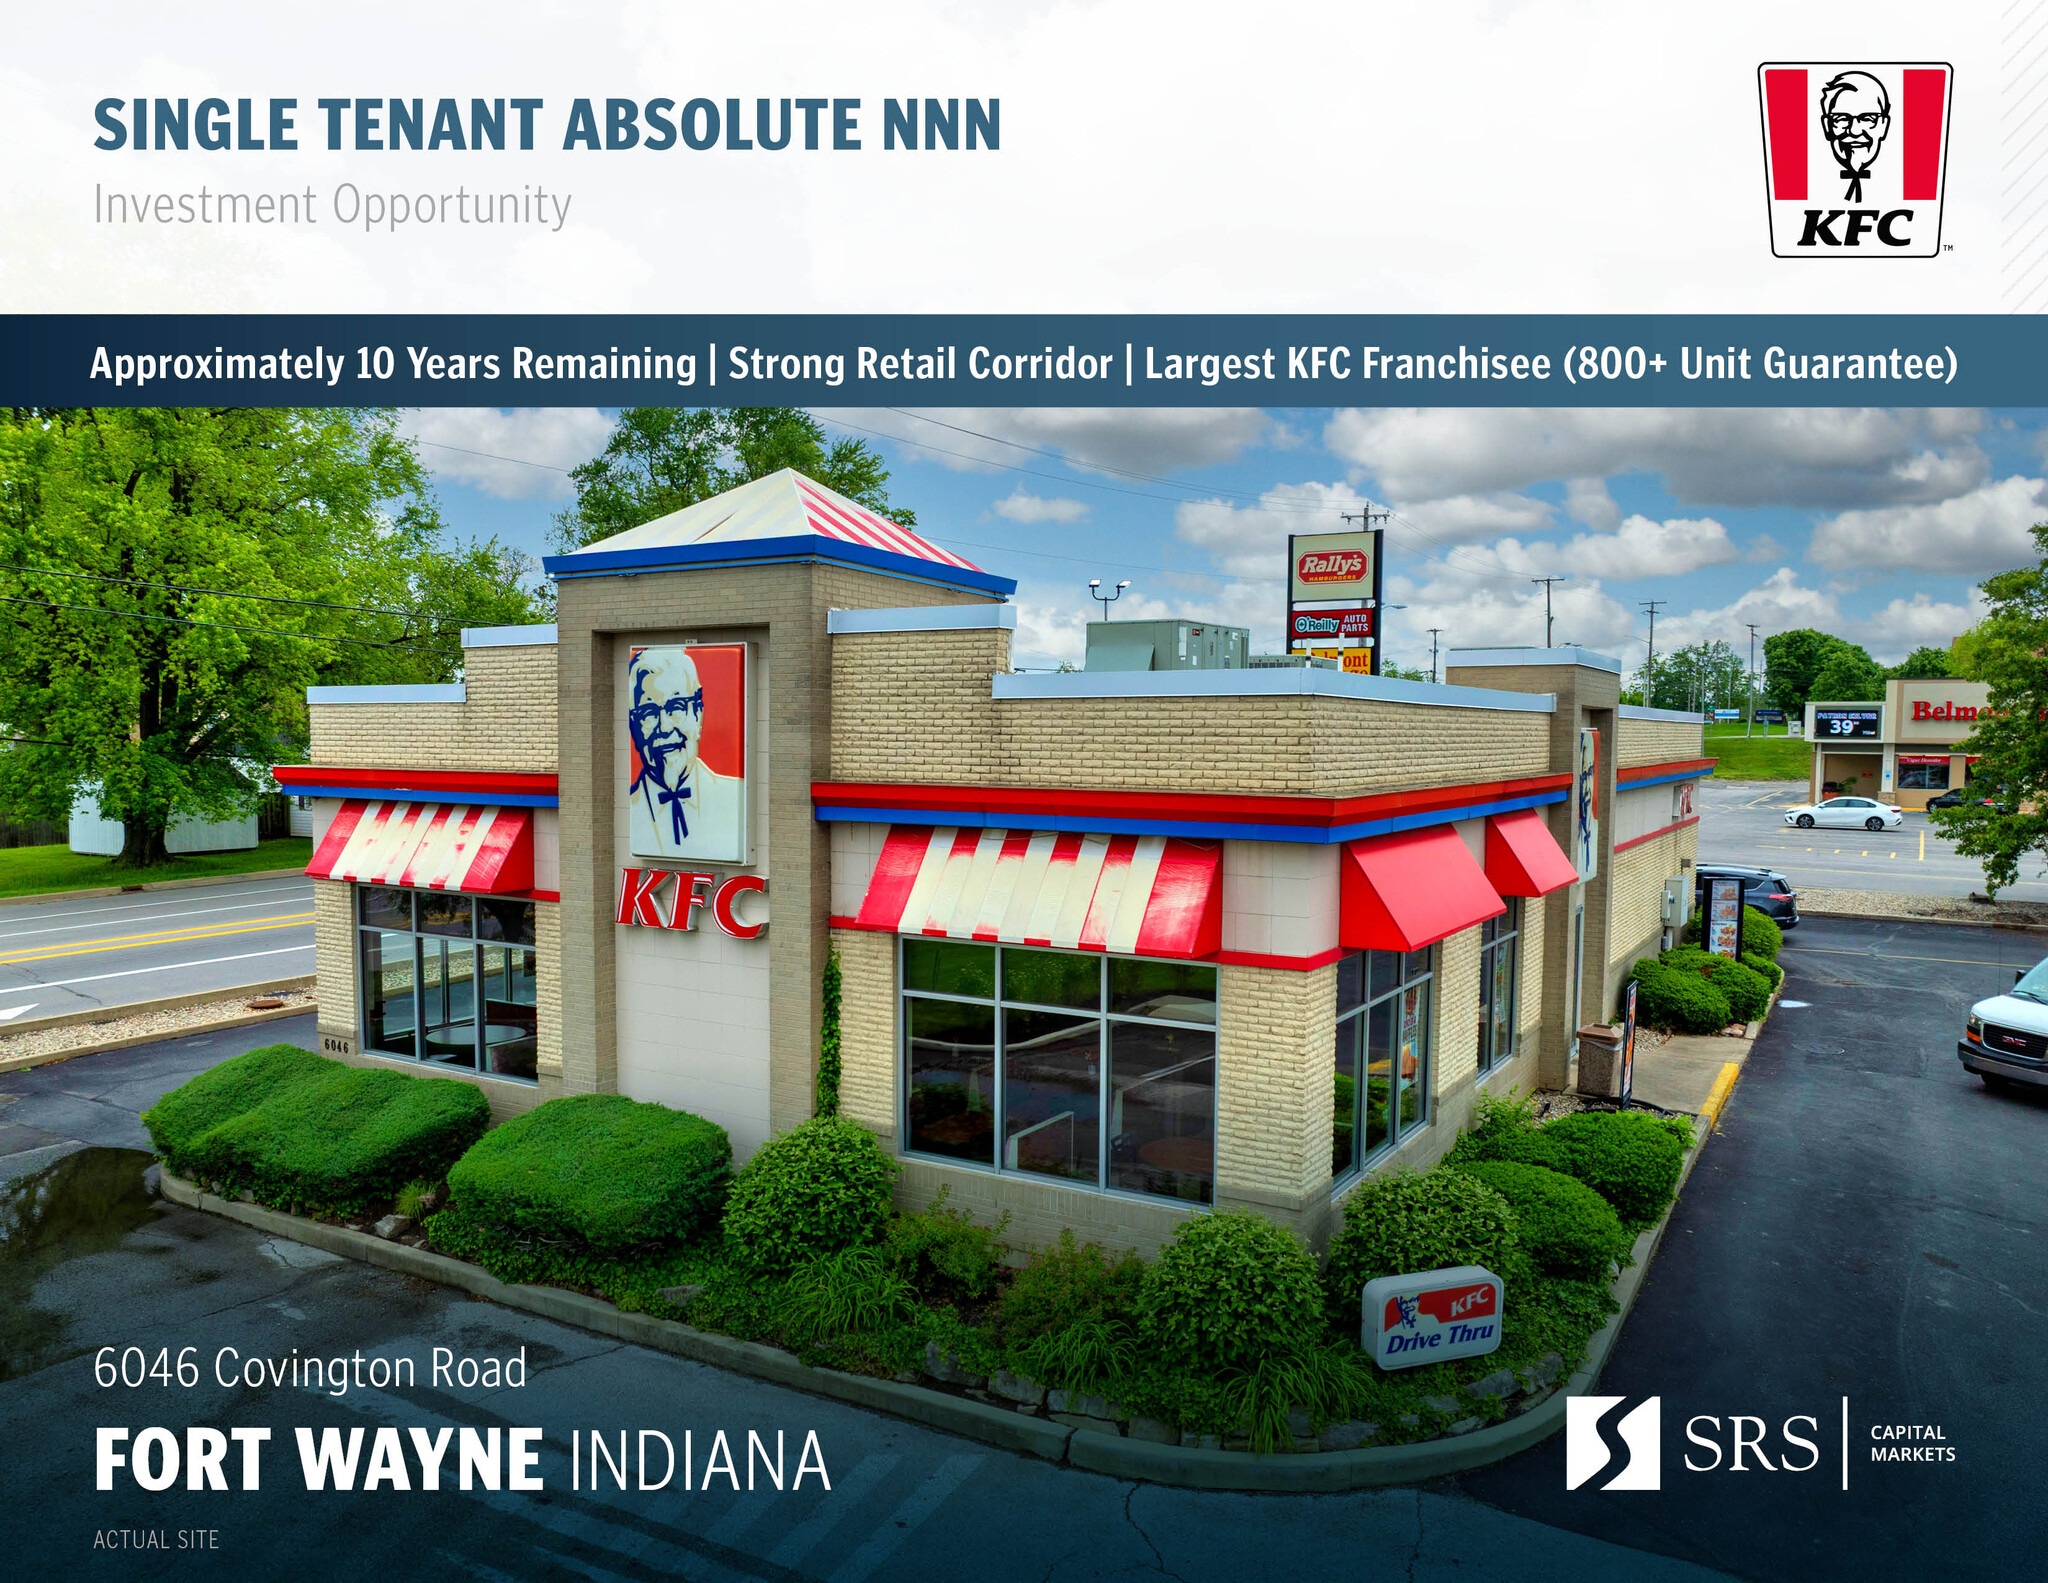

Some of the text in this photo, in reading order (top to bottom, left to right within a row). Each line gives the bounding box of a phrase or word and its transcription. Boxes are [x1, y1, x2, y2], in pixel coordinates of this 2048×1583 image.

[1302, 554, 1362, 576] Rally's
[1308, 574, 1357, 582] HAMBURGERS
[1295, 616, 1340, 633] O'Reilly
[1344, 614, 1367, 623] AUTO
[1341, 623, 1369, 632] PARTS
[615, 867, 769, 940] KFC
[325, 1038, 349, 1054] 6046
[1450, 1286, 1489, 1318] KFC
[1386, 1323, 1495, 1355] Drive Thru
